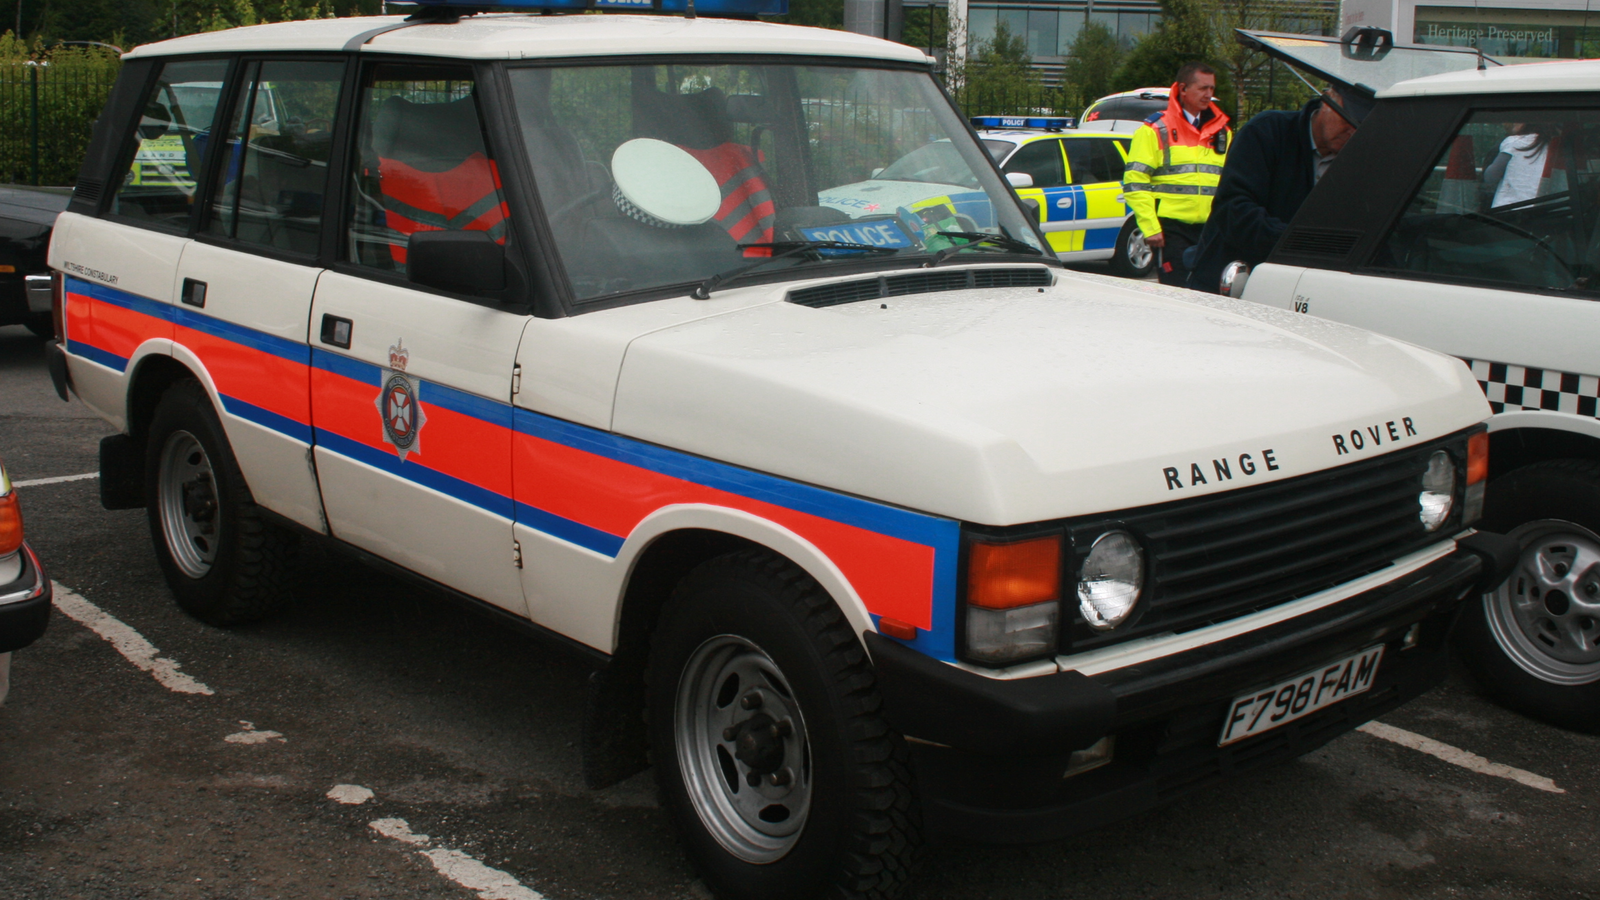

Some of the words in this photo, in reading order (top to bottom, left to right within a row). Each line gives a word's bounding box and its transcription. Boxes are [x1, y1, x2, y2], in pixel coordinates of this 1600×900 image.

[1428, 24, 1483, 44] Heritage
[1488, 26, 1553, 43] Preserved
[819, 196, 870, 209] OLICE
[85, 266, 119, 285] CONSTABULARY
[1295, 301, 1309, 314] V8
[1162, 449, 1280, 490] RANGE
[1332, 417, 1417, 456] ROVER
[1225, 676, 1315, 740] F798
[1314, 651, 1379, 705] FAM
